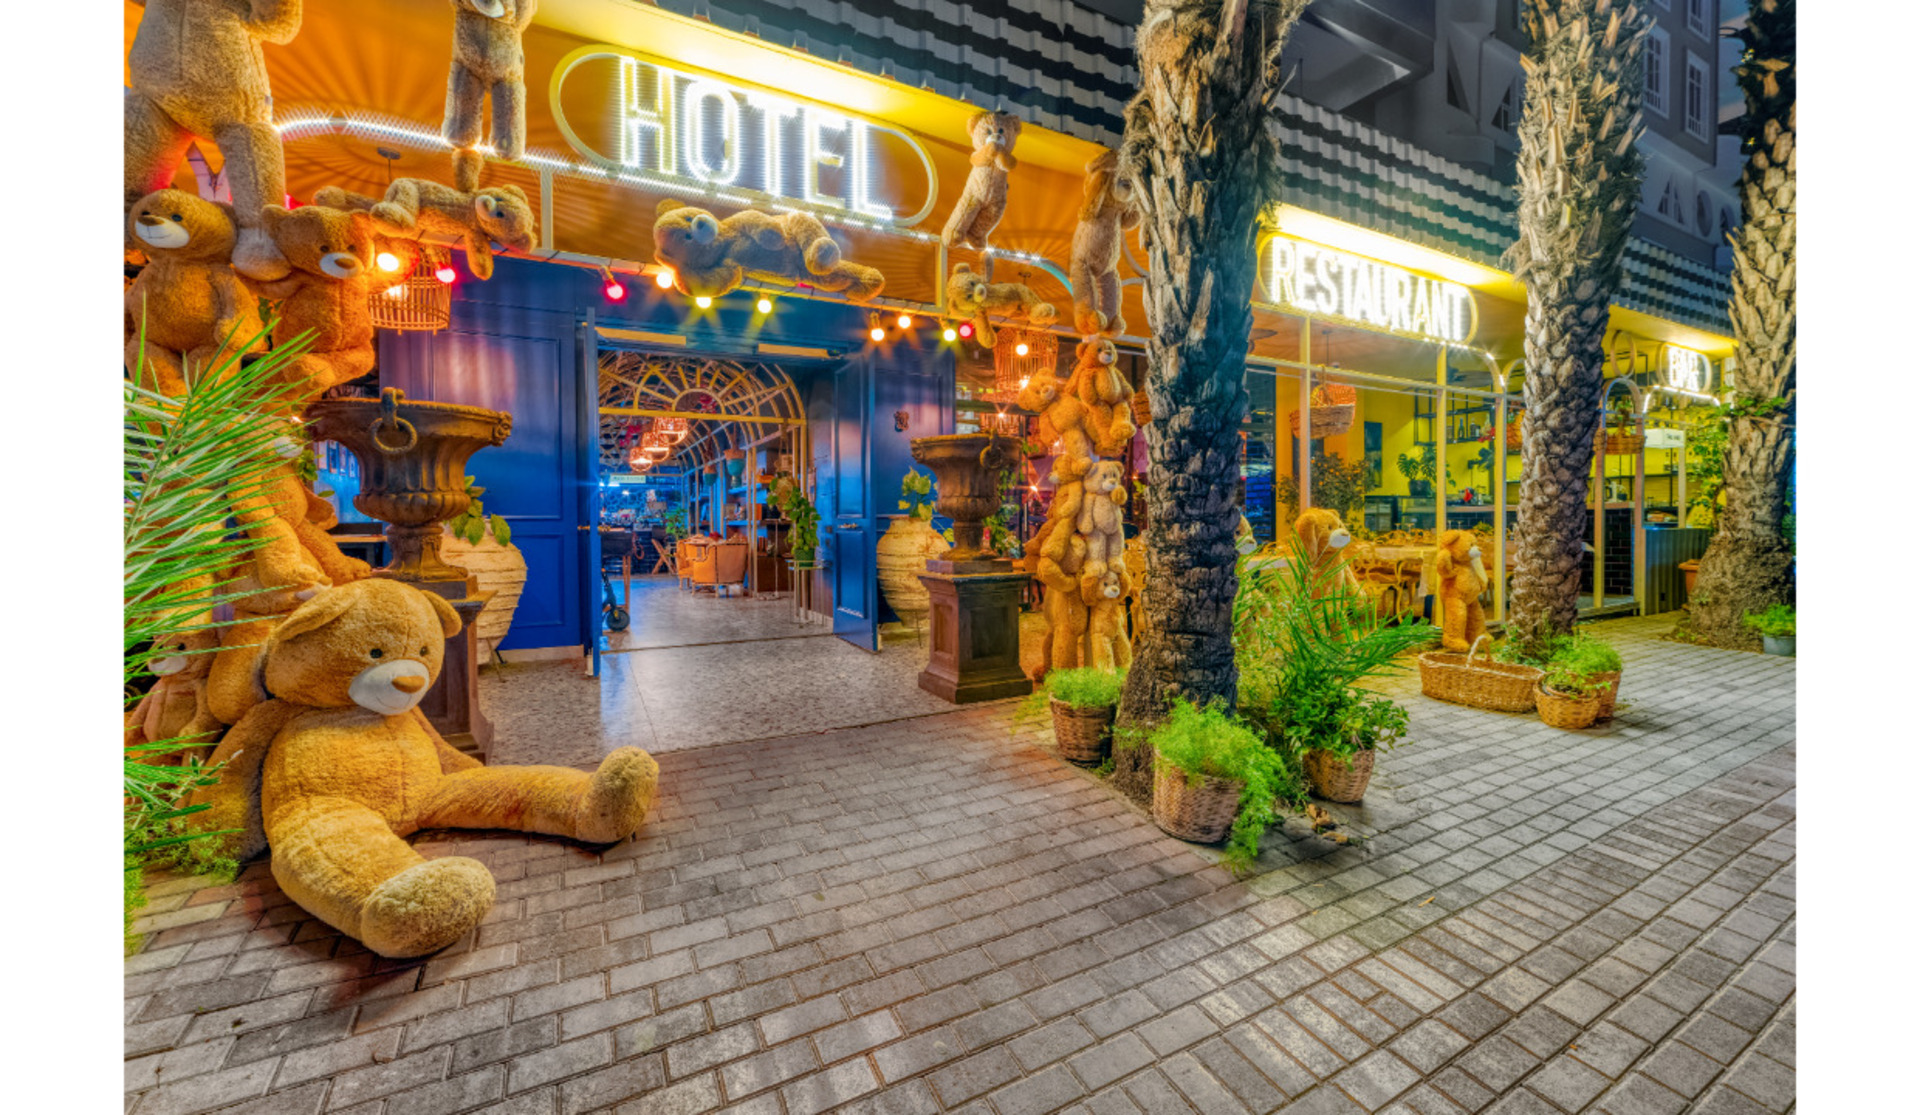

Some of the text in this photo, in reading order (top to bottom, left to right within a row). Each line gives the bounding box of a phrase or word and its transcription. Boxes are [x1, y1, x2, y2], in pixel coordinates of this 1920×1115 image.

[619, 56, 893, 220] HOTEL
[1271, 236, 1469, 342] RESTAURANT
[1669, 346, 1699, 392] BAR
